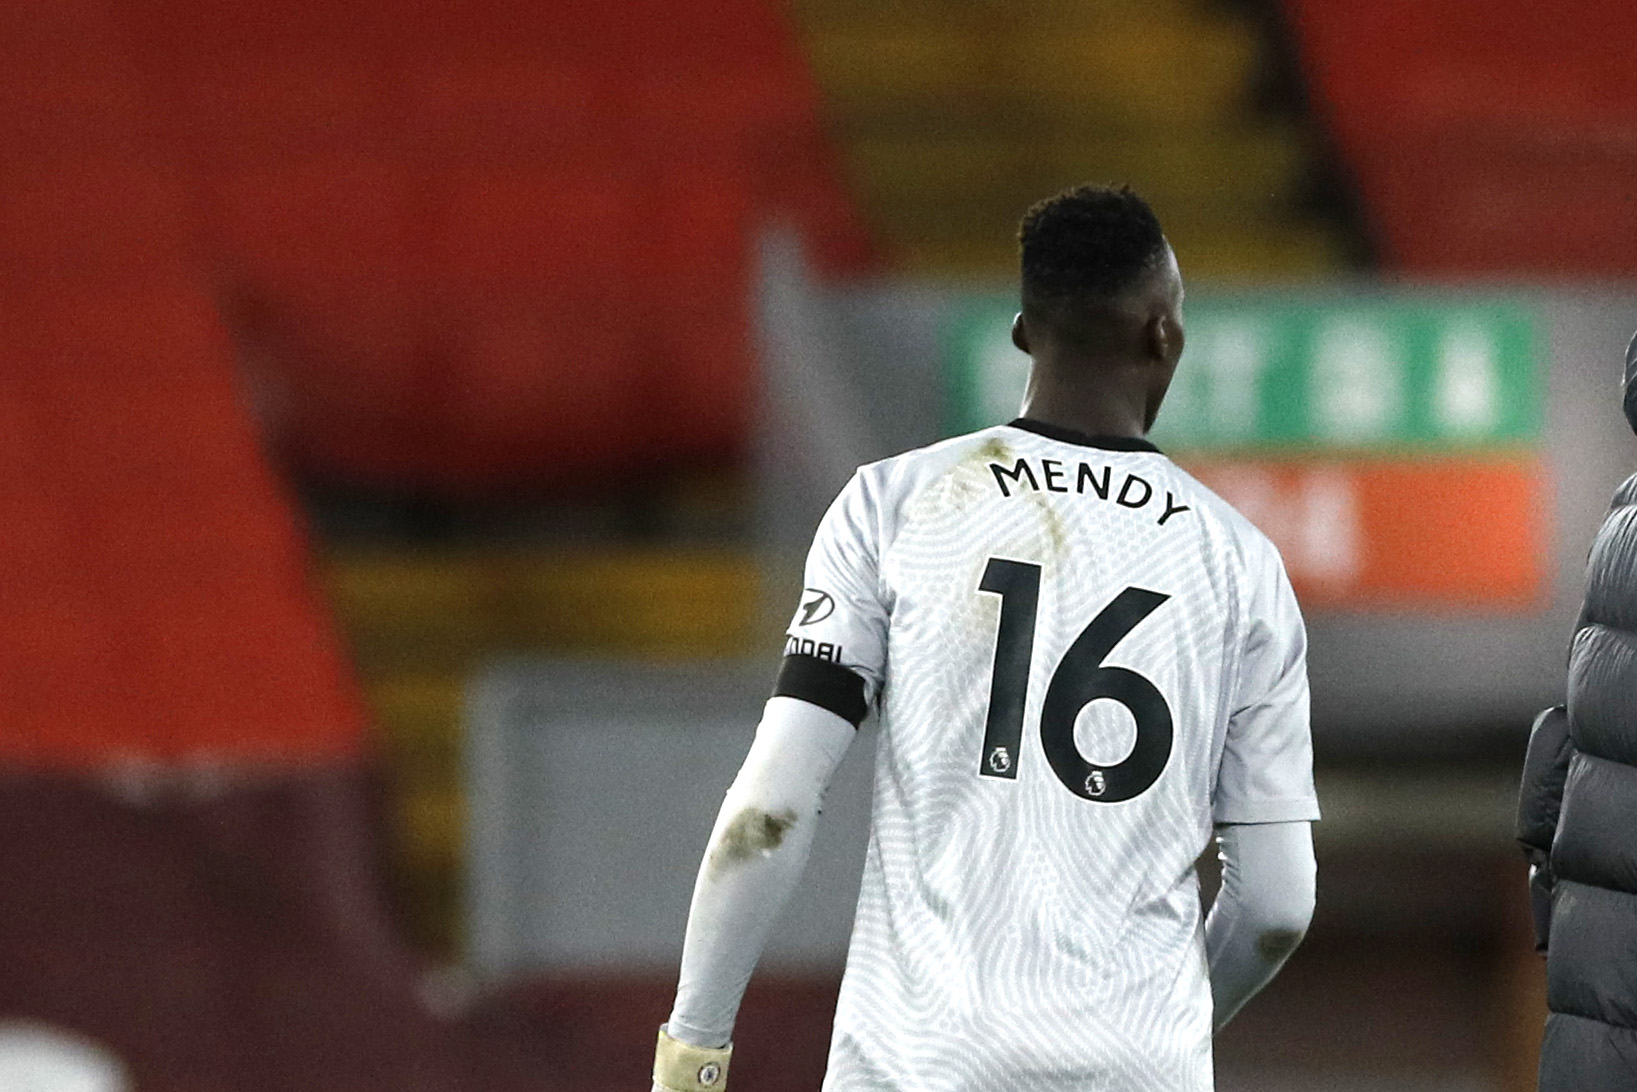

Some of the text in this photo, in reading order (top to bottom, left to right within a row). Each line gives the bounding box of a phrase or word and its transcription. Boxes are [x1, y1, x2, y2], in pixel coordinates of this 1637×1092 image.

[989, 458, 1192, 527] MENDY
[786, 635, 843, 664] NDAI
[976, 555, 1175, 803] 16
